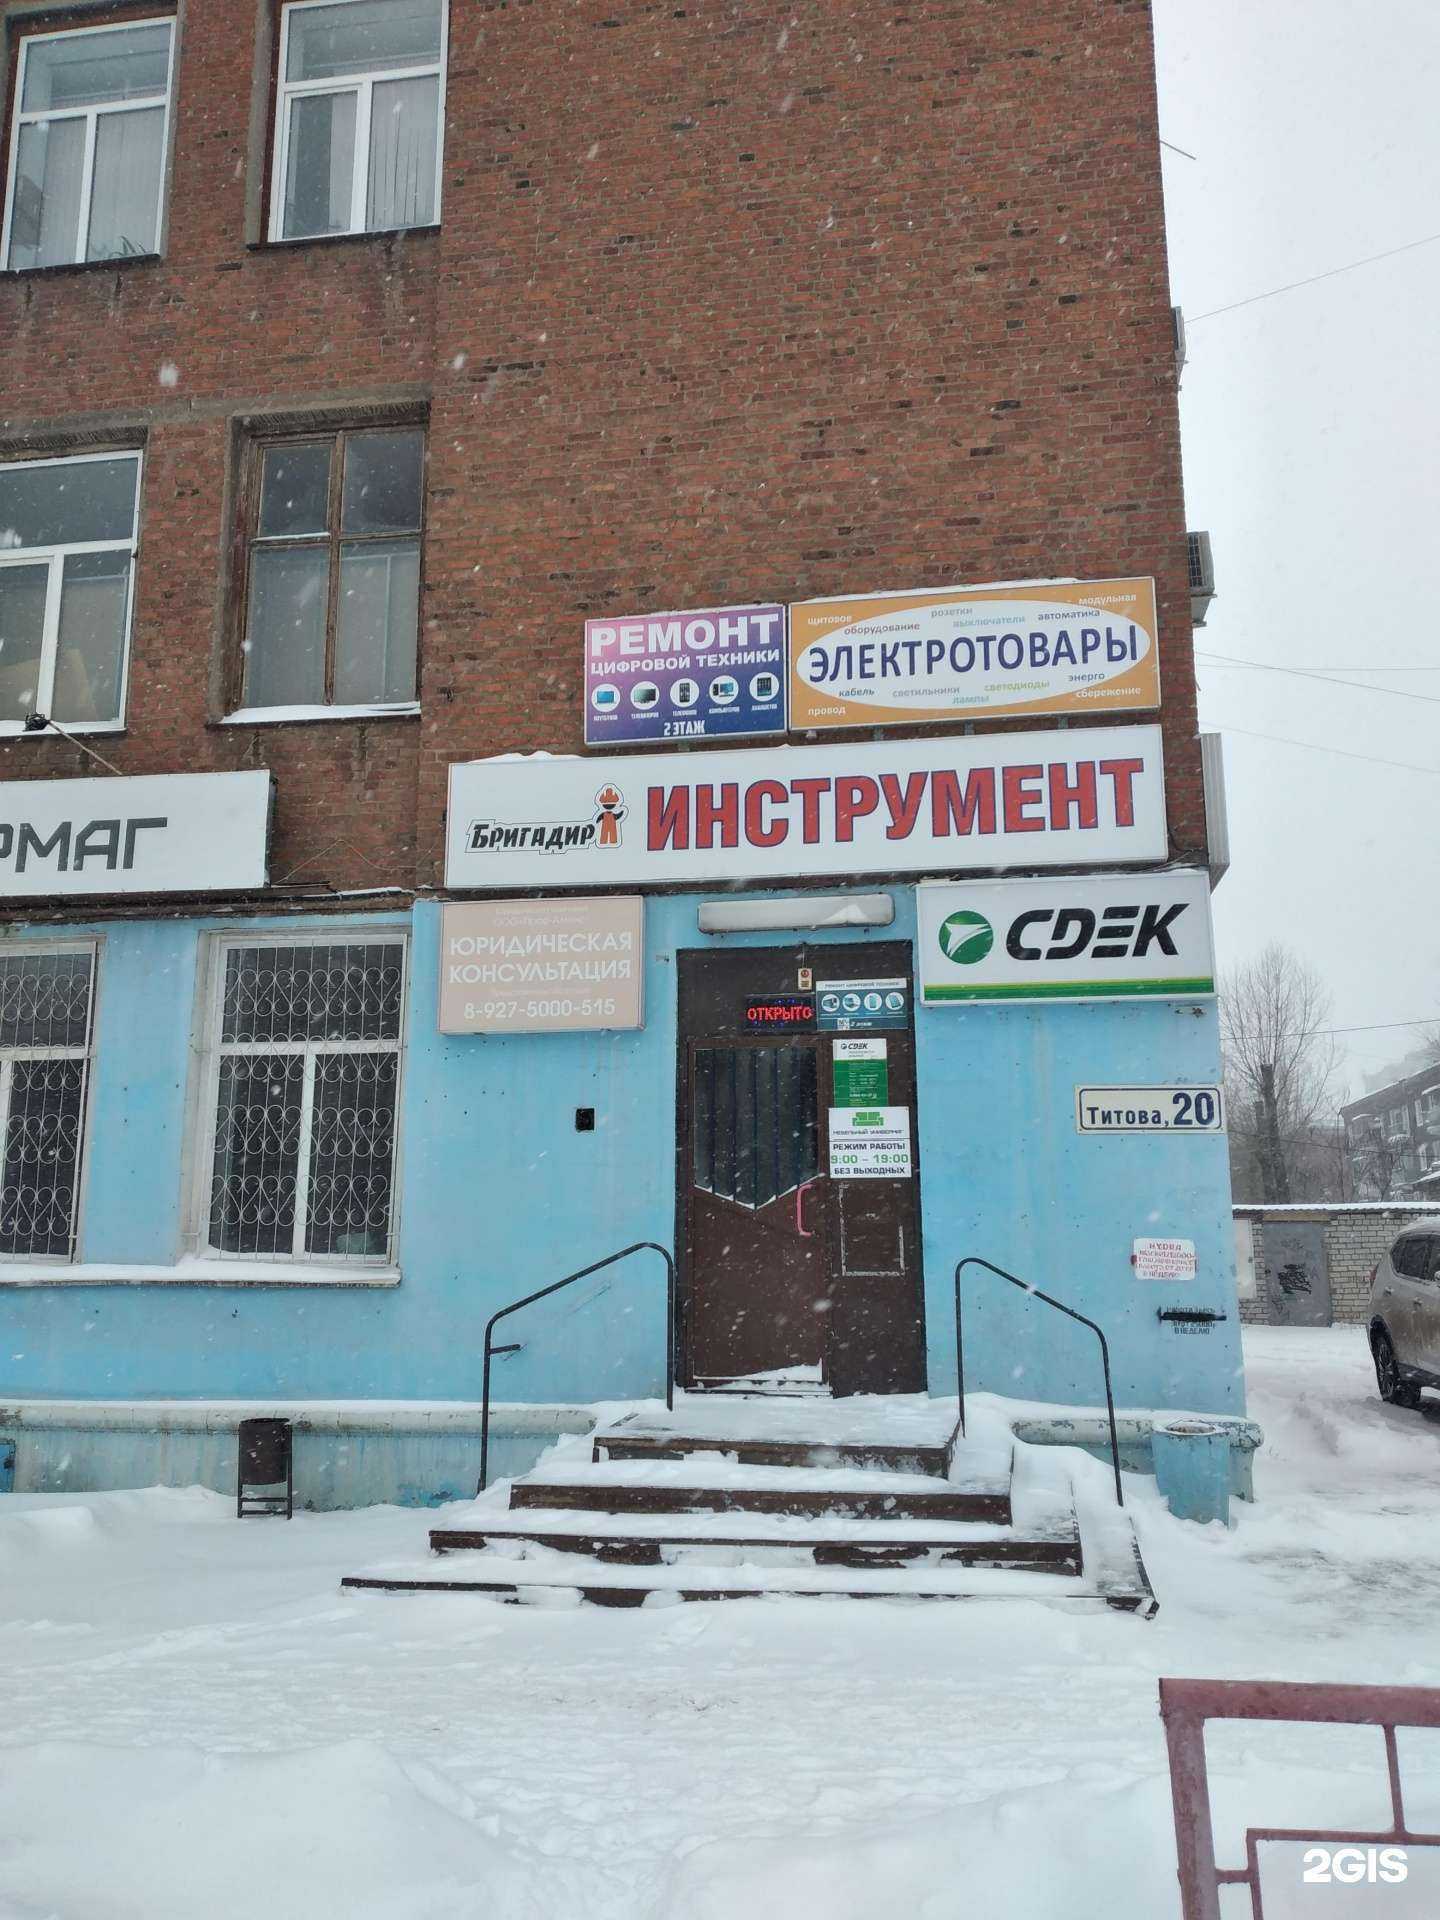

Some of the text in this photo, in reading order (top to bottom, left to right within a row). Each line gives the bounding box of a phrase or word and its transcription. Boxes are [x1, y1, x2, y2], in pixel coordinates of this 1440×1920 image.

[808, 615, 852, 626] щитовое
[1038, 610, 1100, 621] автоматика
[591, 613, 779, 657] РЕМОНТ
[844, 623, 920, 635] оборудование
[809, 625, 1138, 682] ЭЛЕКТРОТОВАРЫ
[591, 649, 780, 676] ЦИФРОВОЙ ТЕХНИКИ
[1068, 672, 1105, 683] энерго
[838, 688, 875, 697] кабель
[984, 681, 1050, 693] светодиоды
[1076, 688, 1141, 699] сбережение
[808, 706, 846, 716] провод
[664, 720, 705, 735] 2 ЭТАЖ
[646, 758, 1144, 851] ИНСТРУМЕНТ
[1006, 903, 1190, 961] CDEK
[450, 931, 632, 957] ЮРИДИЧЕСКАЯ
[450, 959, 631, 984] КОНСУЛЬТАЦИЯ
[463, 998, 616, 1019] 8-927-5000-515
[747, 1005, 813, 1021] ОТКРЫТО
[833, 1142, 905, 1151] РЕЖИМ РАБОТЫ
[831, 1154, 858, 1164] 9:00
[873, 1153, 909, 1164] 19:00
[853, 1166, 905, 1175] ВЫХОДНЫХ
